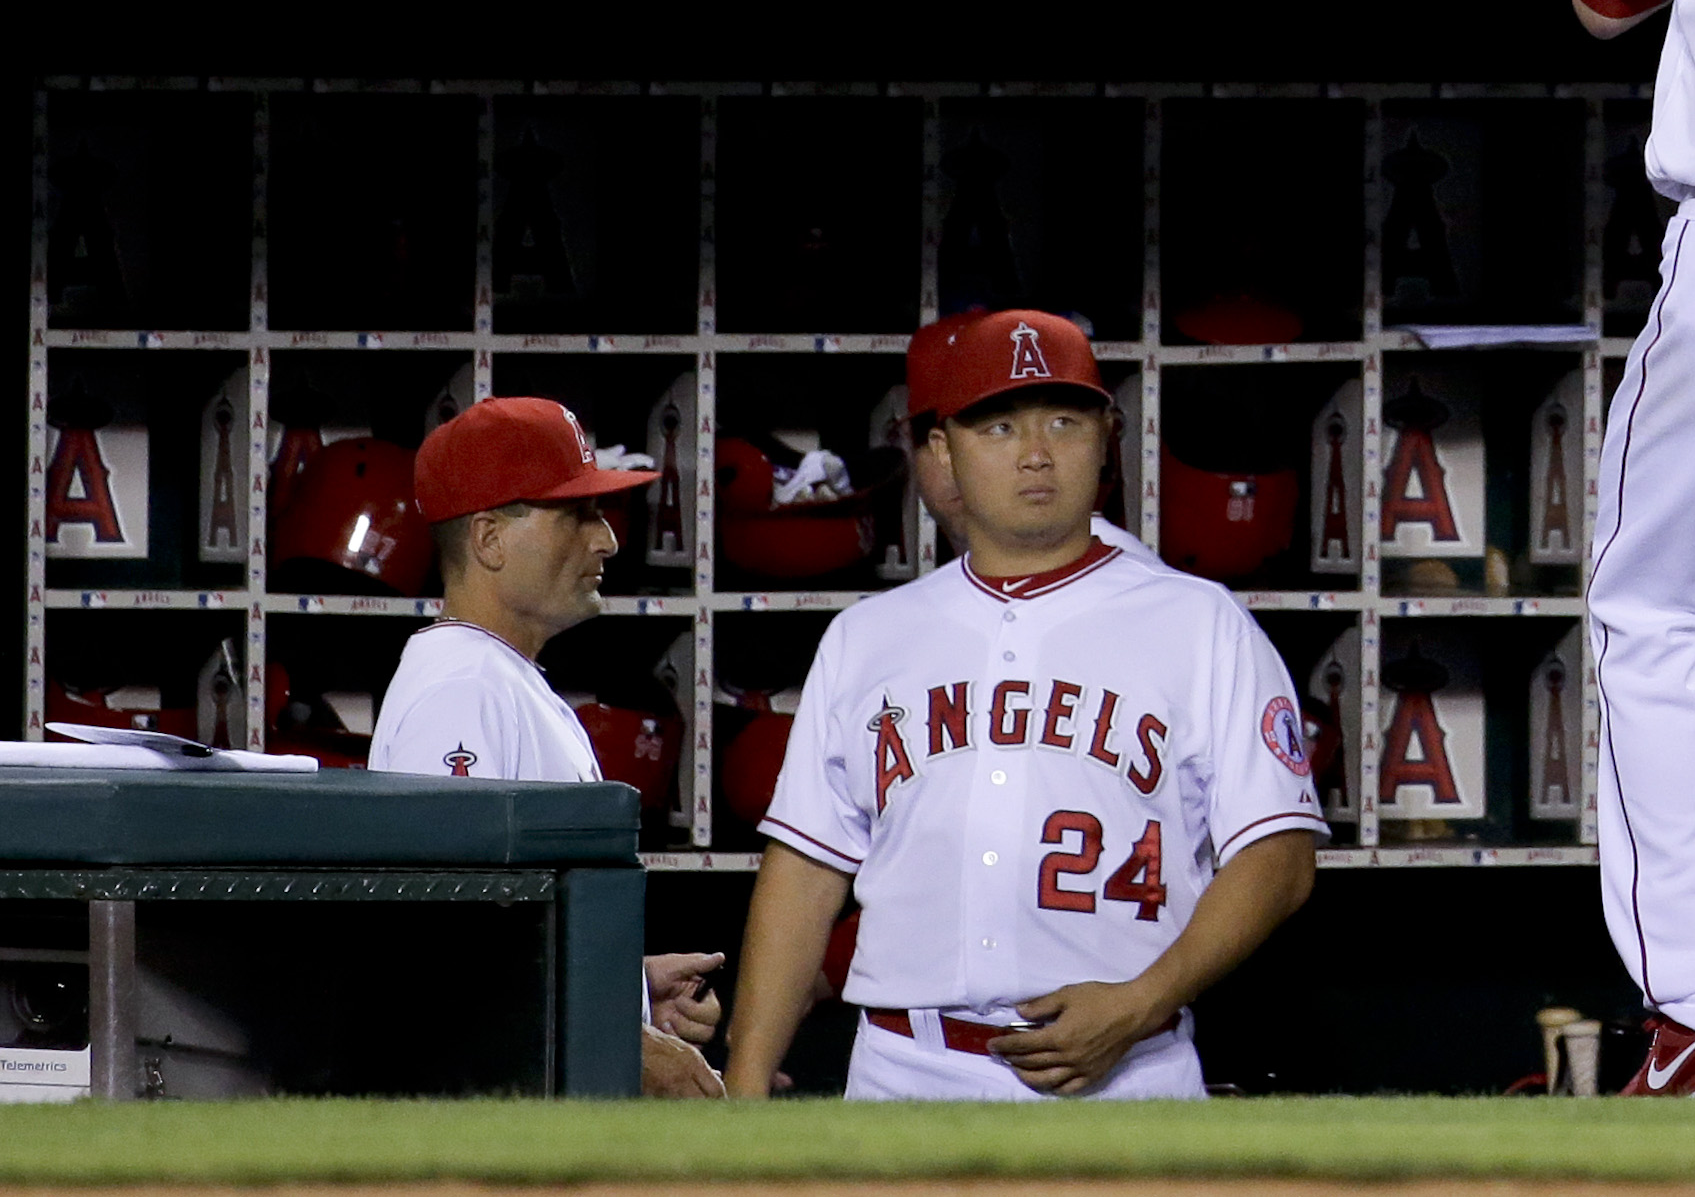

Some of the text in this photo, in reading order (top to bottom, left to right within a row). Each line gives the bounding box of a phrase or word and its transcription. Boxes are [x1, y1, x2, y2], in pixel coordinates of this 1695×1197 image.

[1009, 321, 1052, 379] A
[867, 679, 1167, 818] ANGELS
[1038, 809, 1167, 922] 24
[0, 1059, 67, 1072] Telemetrics
